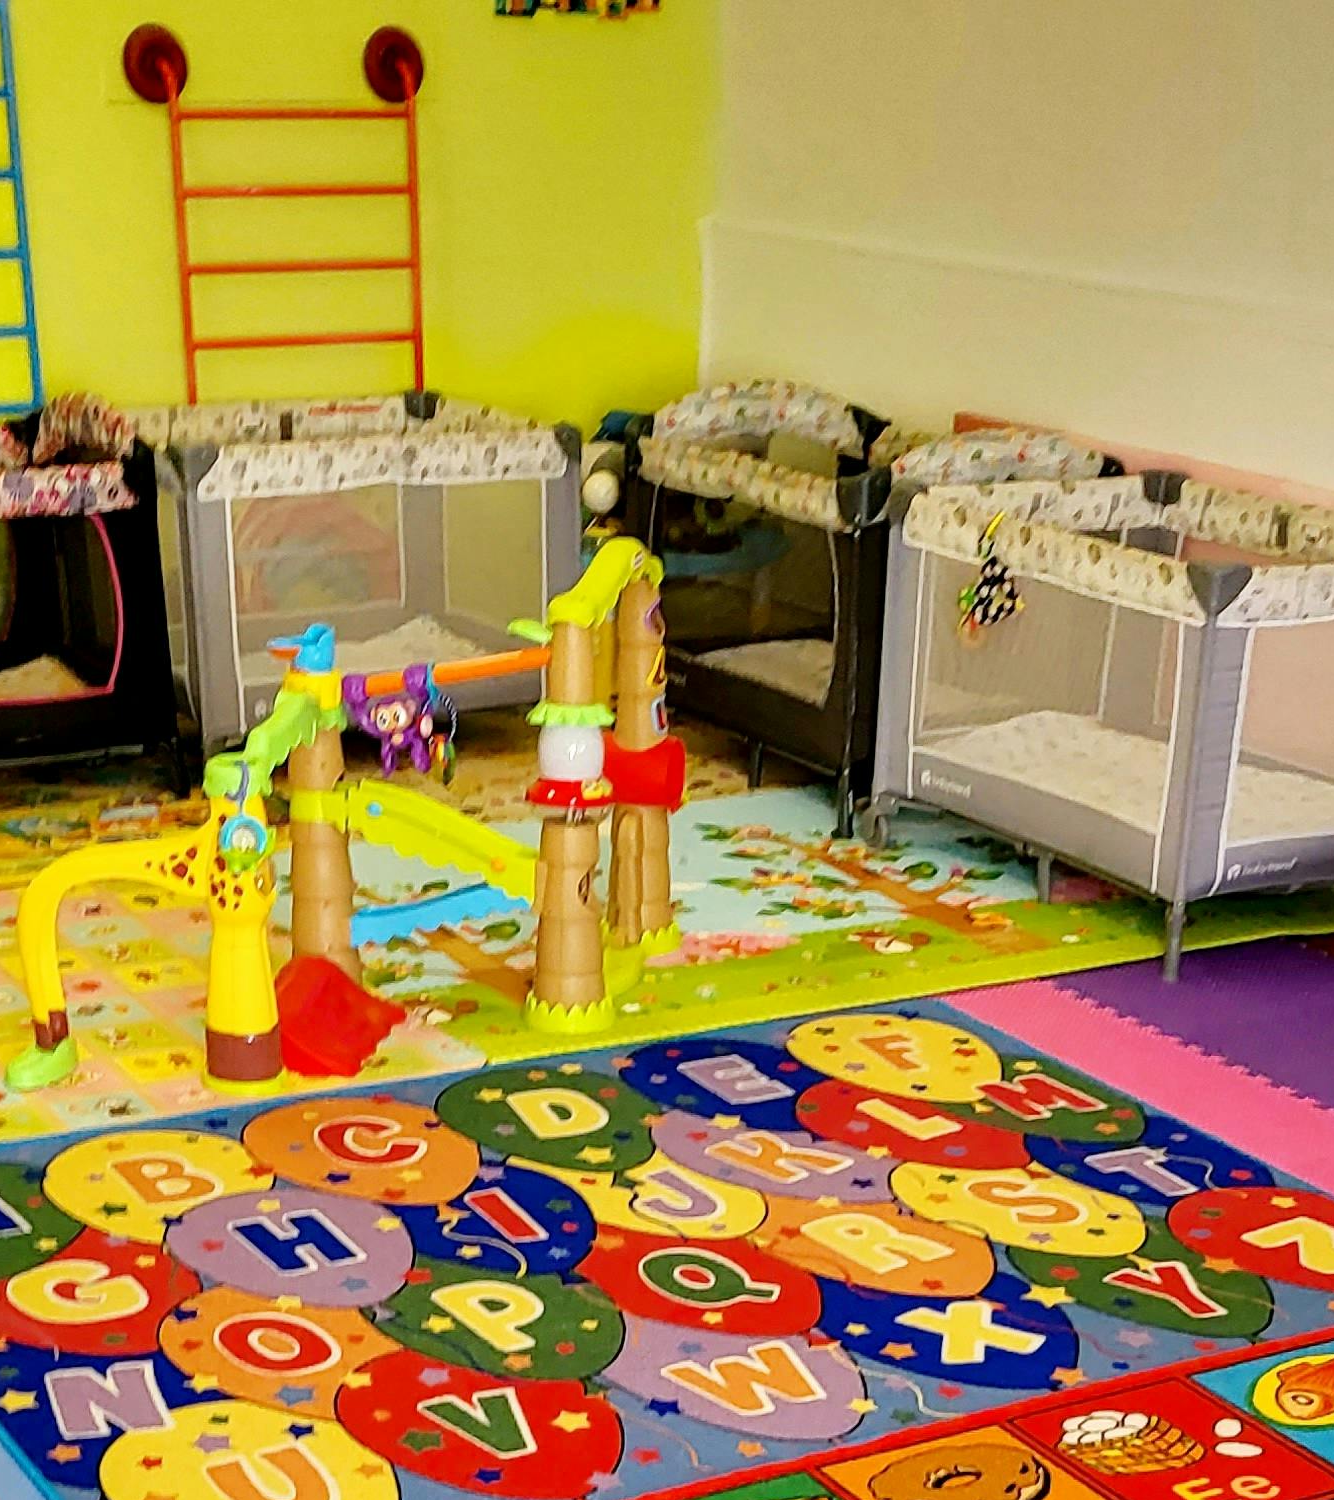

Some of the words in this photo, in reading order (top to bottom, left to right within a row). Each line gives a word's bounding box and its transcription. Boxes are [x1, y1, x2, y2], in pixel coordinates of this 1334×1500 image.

[677, 1054, 795, 1104] E
[853, 1032, 929, 1073] F
[506, 1087, 609, 1139] D
[856, 1098, 964, 1141] L
[976, 1074, 1108, 1121] M
[314, 1115, 427, 1166] C
[107, 1155, 223, 1205] B
[633, 1169, 726, 1222] J
[1084, 1147, 1200, 1196] T
[464, 1187, 549, 1244] I
[965, 1177, 1090, 1227] S
[228, 1209, 368, 1275] H
[799, 1212, 954, 1274] R
[7, 1258, 149, 1324] G
[638, 1246, 781, 1303] Q
[1103, 1261, 1229, 1319] Y
[213, 1311, 342, 1376] O
[431, 1279, 543, 1353] P
[893, 1301, 1047, 1364] X
[45, 1360, 176, 1440] N
[660, 1340, 827, 1416] W
[417, 1387, 536, 1459] V
